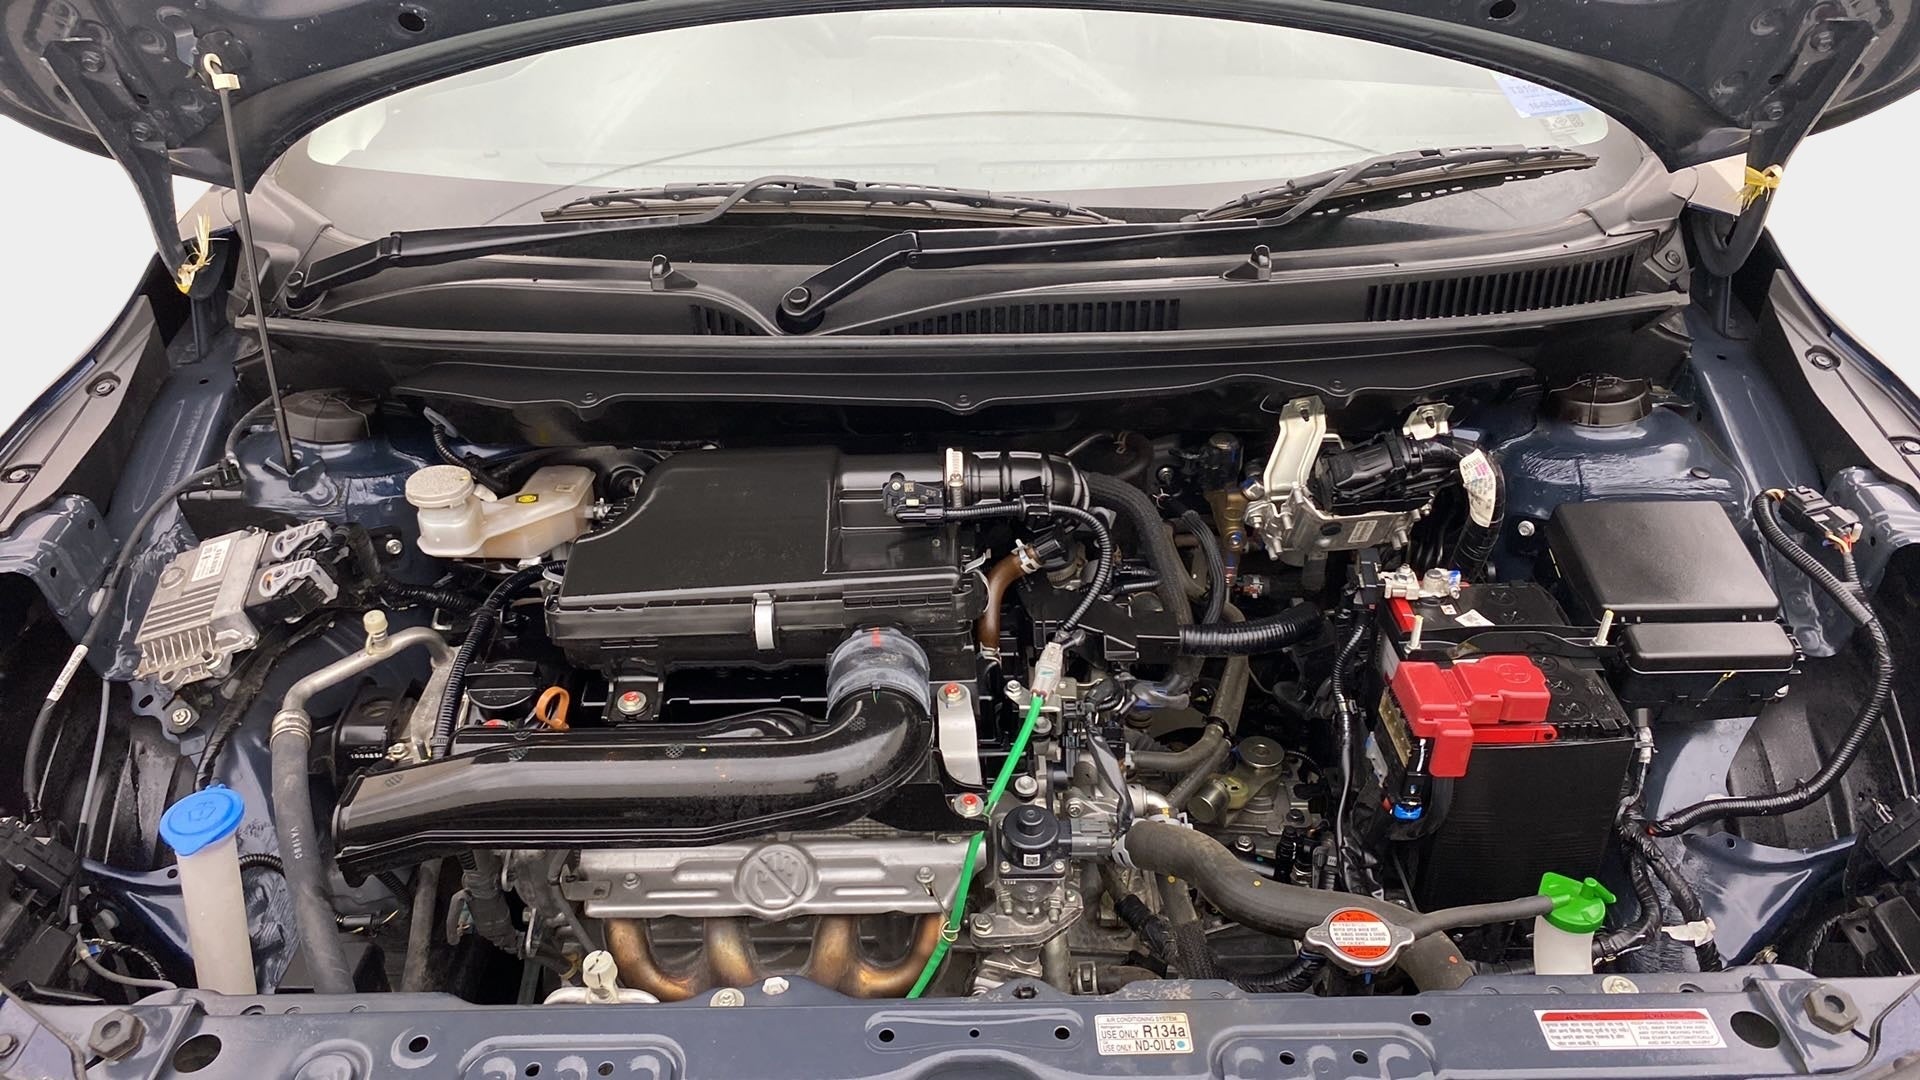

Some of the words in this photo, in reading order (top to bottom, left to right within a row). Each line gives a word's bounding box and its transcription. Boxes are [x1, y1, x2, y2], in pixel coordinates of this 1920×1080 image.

[1101, 1030, 1117, 1039] USE
[1118, 1029, 1139, 1039] ONLY
[1142, 1024, 1186, 1038] R134a
[1103, 1044, 1114, 1052] USE
[1116, 1043, 1132, 1052] ONLY
[1135, 1039, 1176, 1051] ND-OIL8
